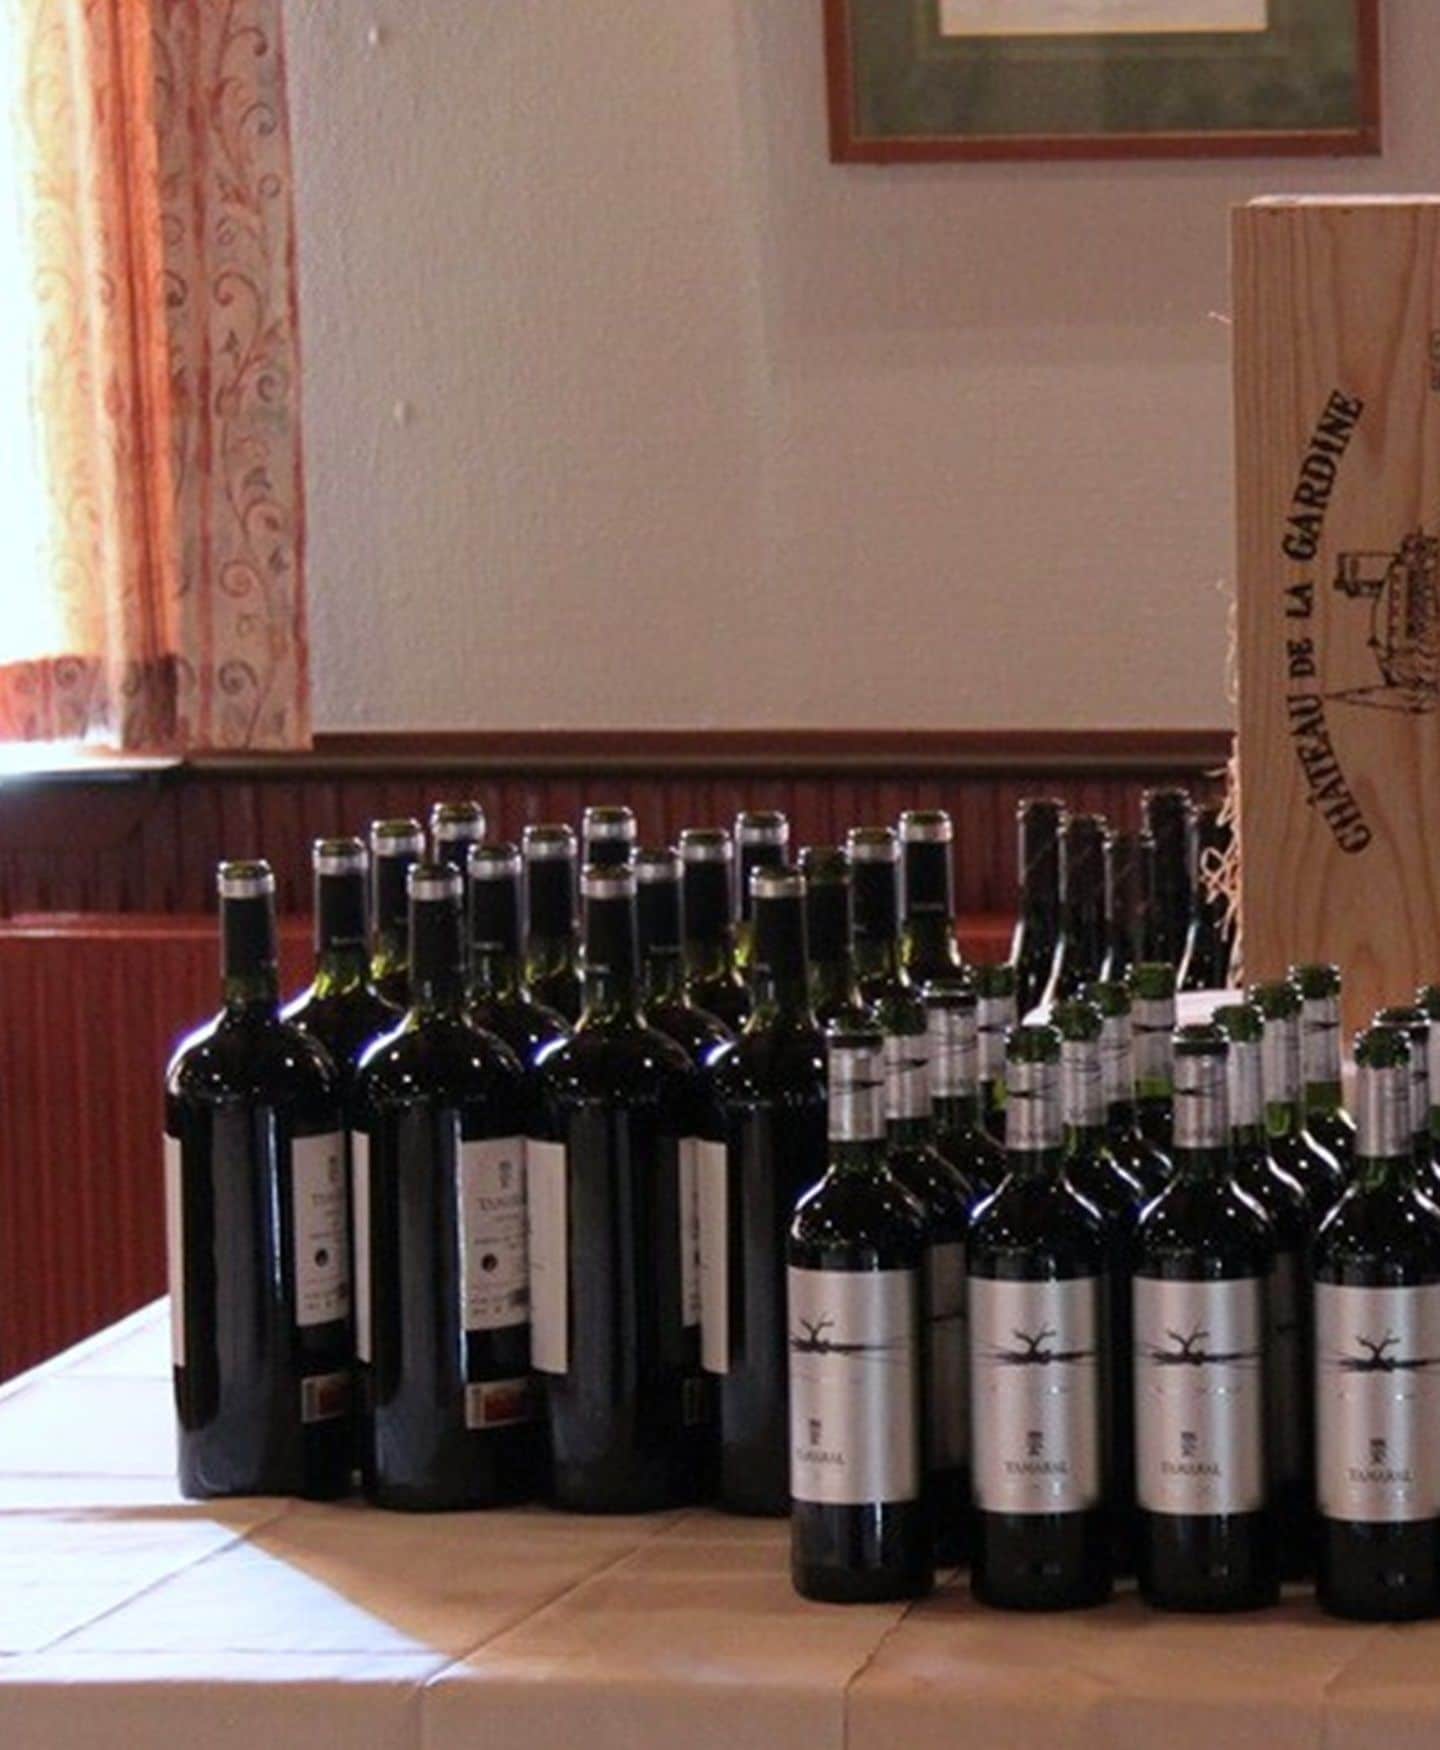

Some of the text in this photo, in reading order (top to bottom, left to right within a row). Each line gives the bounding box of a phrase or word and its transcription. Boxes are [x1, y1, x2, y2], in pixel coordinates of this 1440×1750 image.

[1281, 388, 1372, 854] CHÂTEAU DE LA GARDINE
